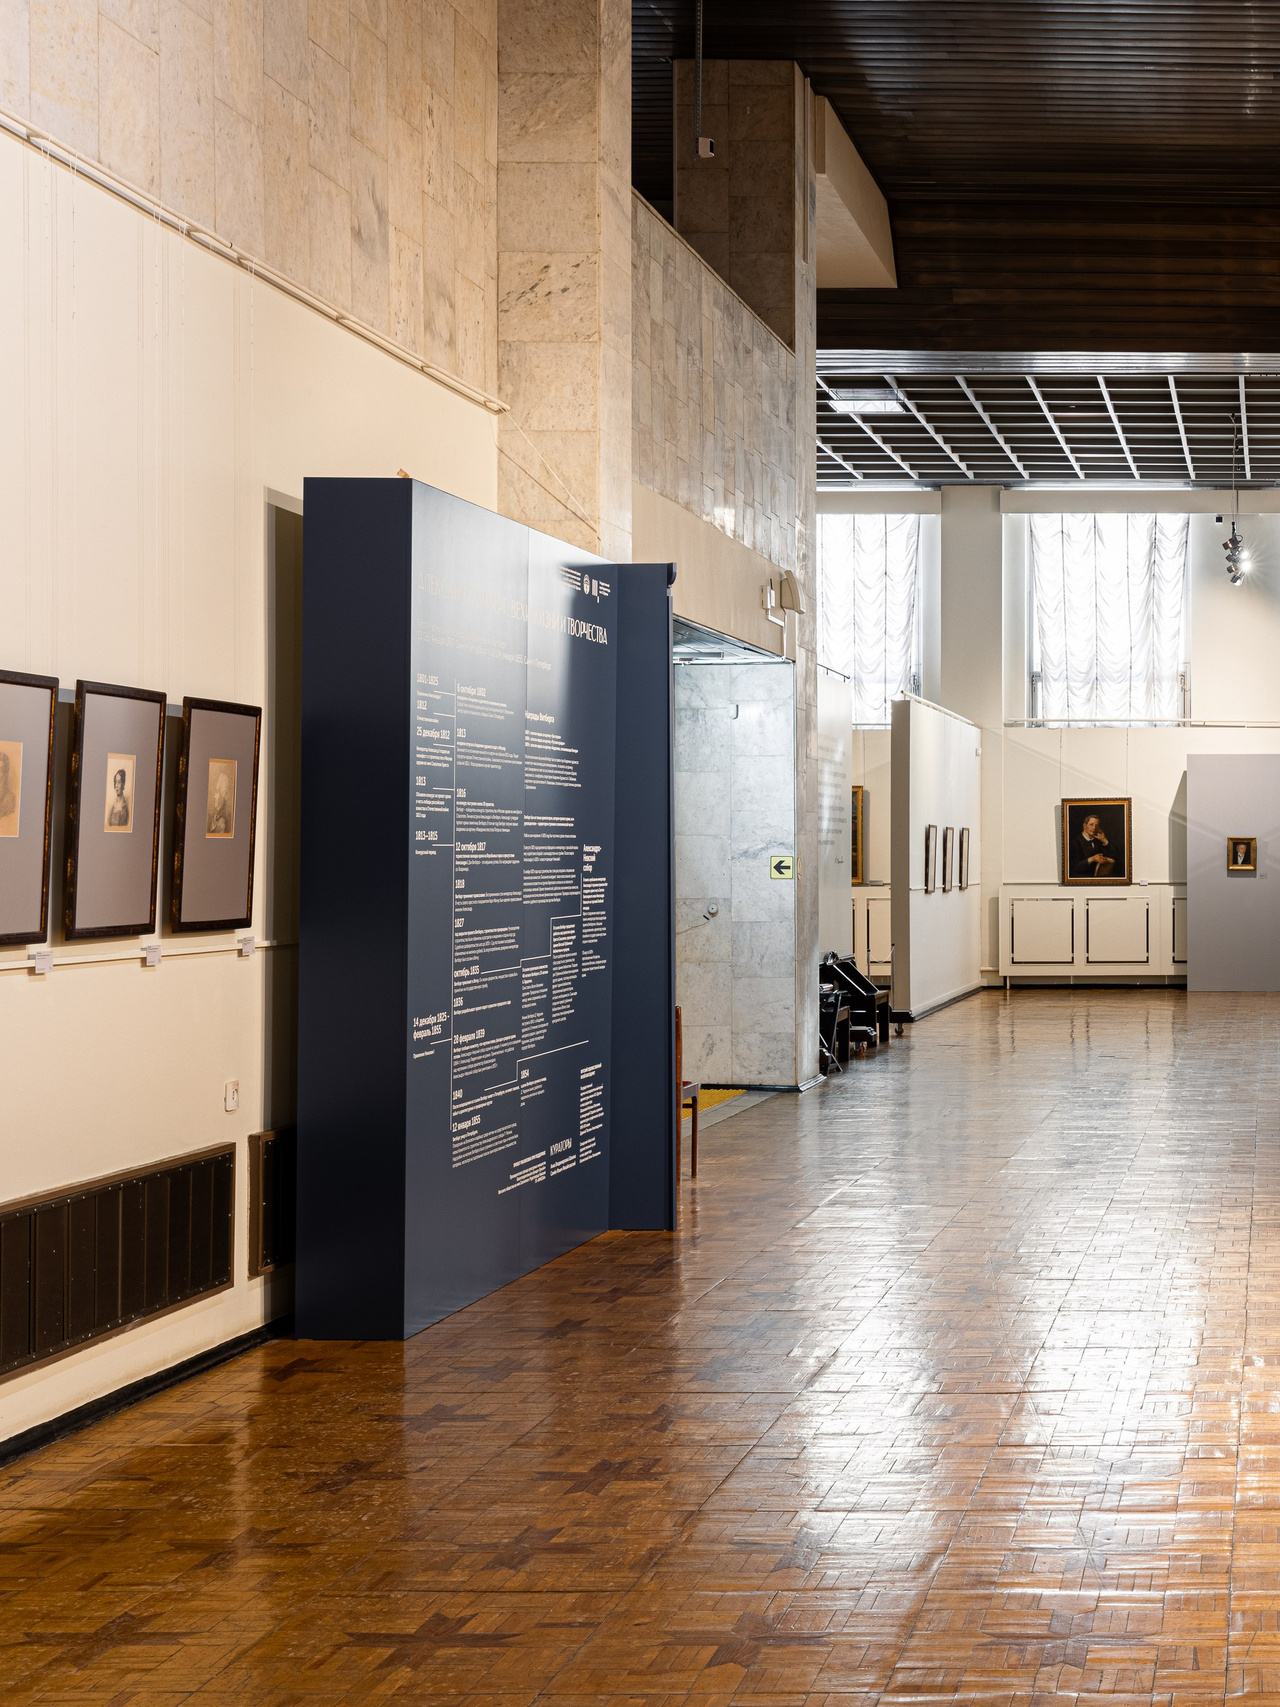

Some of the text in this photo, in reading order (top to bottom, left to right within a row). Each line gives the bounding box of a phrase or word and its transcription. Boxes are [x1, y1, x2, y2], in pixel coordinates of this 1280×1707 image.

[567, 617, 608, 645] ТВОРЧЕСТВА
[417, 700, 427, 710] 1812
[416, 726, 450, 740] 25 декабря 1812
[416, 776, 426, 786] 1813
[456, 842, 486, 853] 12 октября 1817
[583, 863, 592, 873] собор
[455, 918, 464, 928] 1827
[454, 965, 479, 978] октябрь 1835
[454, 997, 463, 1007] 1836
[413, 1017, 419, 1027] 14
[419, 1014, 437, 1027] декабря
[437, 1012, 447, 1022] 1825
[413, 1024, 441, 1041] февраль 1855
[454, 1034, 459, 1044] 28
[459, 1033, 475, 1045] февраля
[521, 1069, 529, 1079] 1854
[453, 1089, 463, 1100] 1840
[452, 1115, 481, 1132] 12 января 1855
[550, 1138, 572, 1156] КУРАТОРЫ
